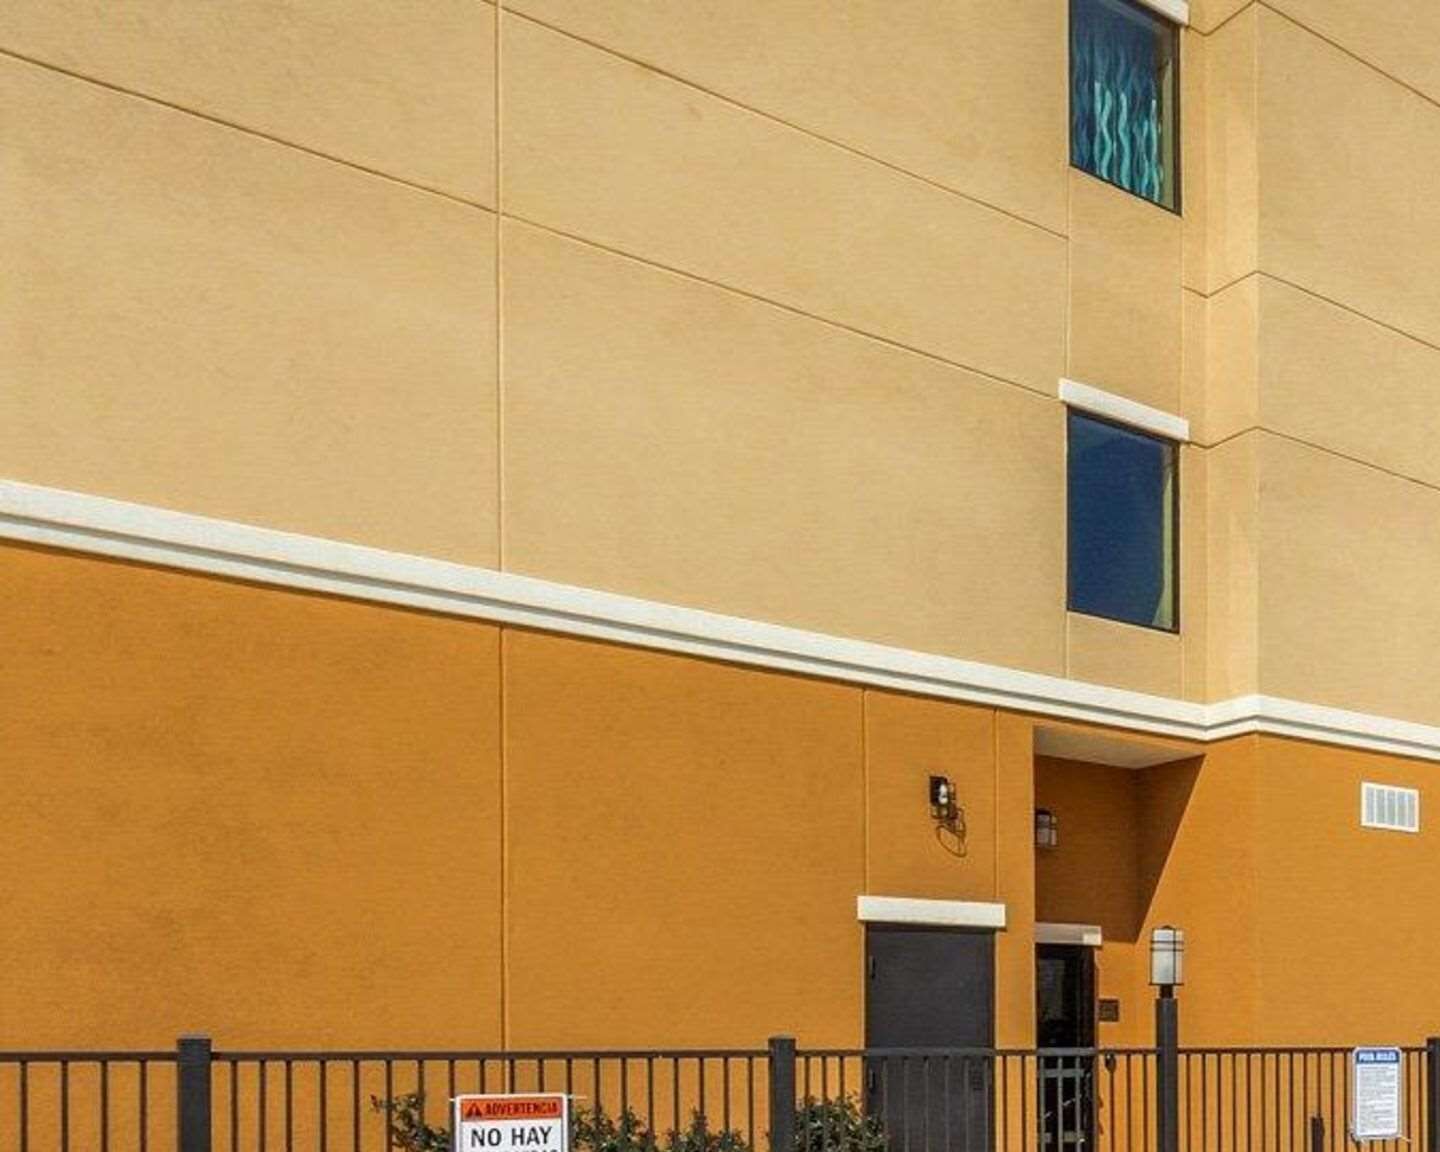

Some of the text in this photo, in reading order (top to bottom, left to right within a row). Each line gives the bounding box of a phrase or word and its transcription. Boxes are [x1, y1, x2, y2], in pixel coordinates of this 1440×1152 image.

[485, 1102, 558, 1115] ADVERTENCIA
[470, 1126, 552, 1147] NO HAY
